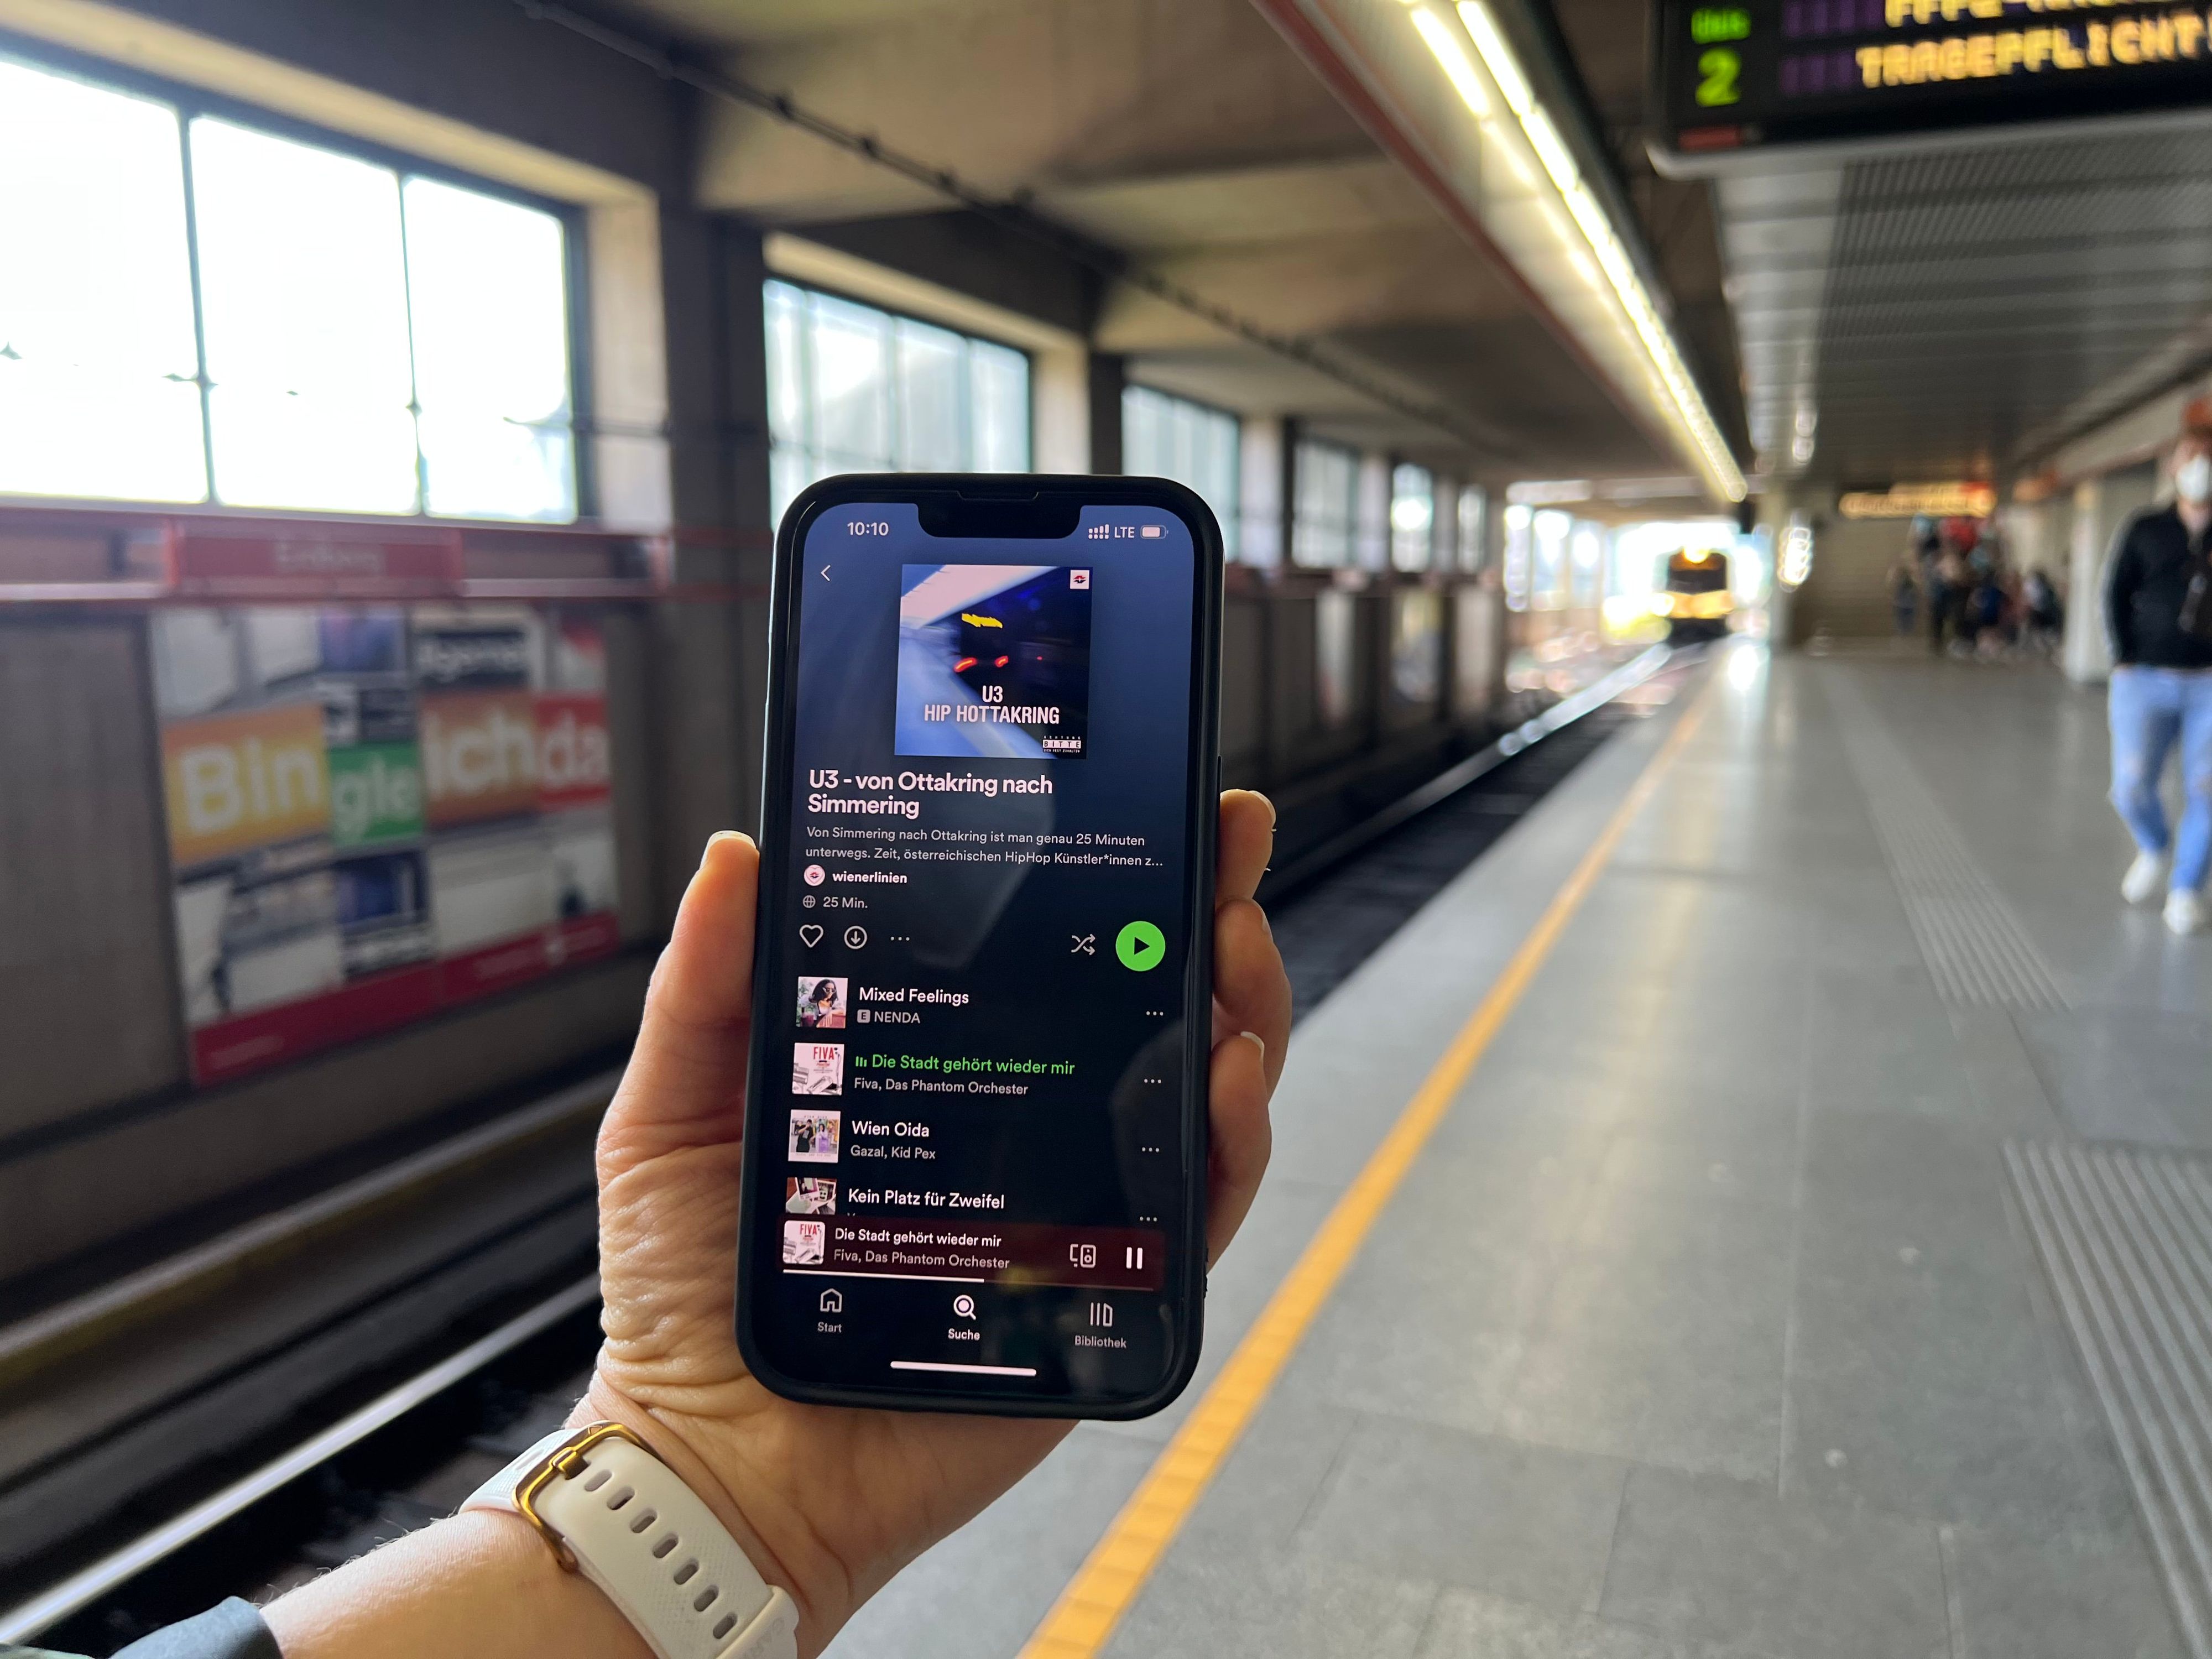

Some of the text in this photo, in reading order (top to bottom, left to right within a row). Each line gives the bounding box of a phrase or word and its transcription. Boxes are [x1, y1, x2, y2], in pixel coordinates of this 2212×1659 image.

[1856, 8, 2212, 89] TRAGEPFLICHT
[1695, 46, 1741, 107] 2
[847, 521, 889, 536] 10:10
[1114, 526, 1135, 538] LTE
[982, 685, 1003, 703] U3
[924, 705, 1060, 724] HIP HOTTAKRING
[810, 769, 839, 789] U3
[855, 775, 894, 790] von
[898, 771, 998, 797] Ottakring
[1003, 774, 1052, 794] nach
[808, 793, 920, 820] Simmering
[806, 826, 1145, 846] Von Simmering nach Ottakring ist man genau 25 Minuten
[806, 847, 870, 860] unterwegs.
[874, 847, 900, 860] Zeit,
[904, 849, 1001, 862] österreichischen
[1005, 851, 1051, 865] HipHop
[832, 870, 907, 884] wienerlinien
[823, 896, 868, 909] 25 Min.
[859, 987, 969, 1006] Mixed Feelings
[874, 1011, 921, 1024] NENDA
[813, 1046, 834, 1060] FIVA
[872, 1054, 1075, 1074] Die Stadt gehört wieder mir
[854, 1077, 1029, 1094] Fiva, Das Phantom Orchester
[852, 1120, 930, 1138] Wien Oida
[851, 1145, 936, 1160] Gazal, Kid Pex
[848, 1188, 1004, 1209] Kein Platz für Zweifel
[800, 1224, 817, 1235] FIVA
[835, 1228, 1002, 1247] Die Stadt gehört wieder mir
[834, 1249, 1010, 1269] Fiva, Das Phantom Orchester
[817, 1321, 842, 1333] Start
[948, 1328, 980, 1340] Suche
[1074, 1335, 1126, 1348] Bibliothek
